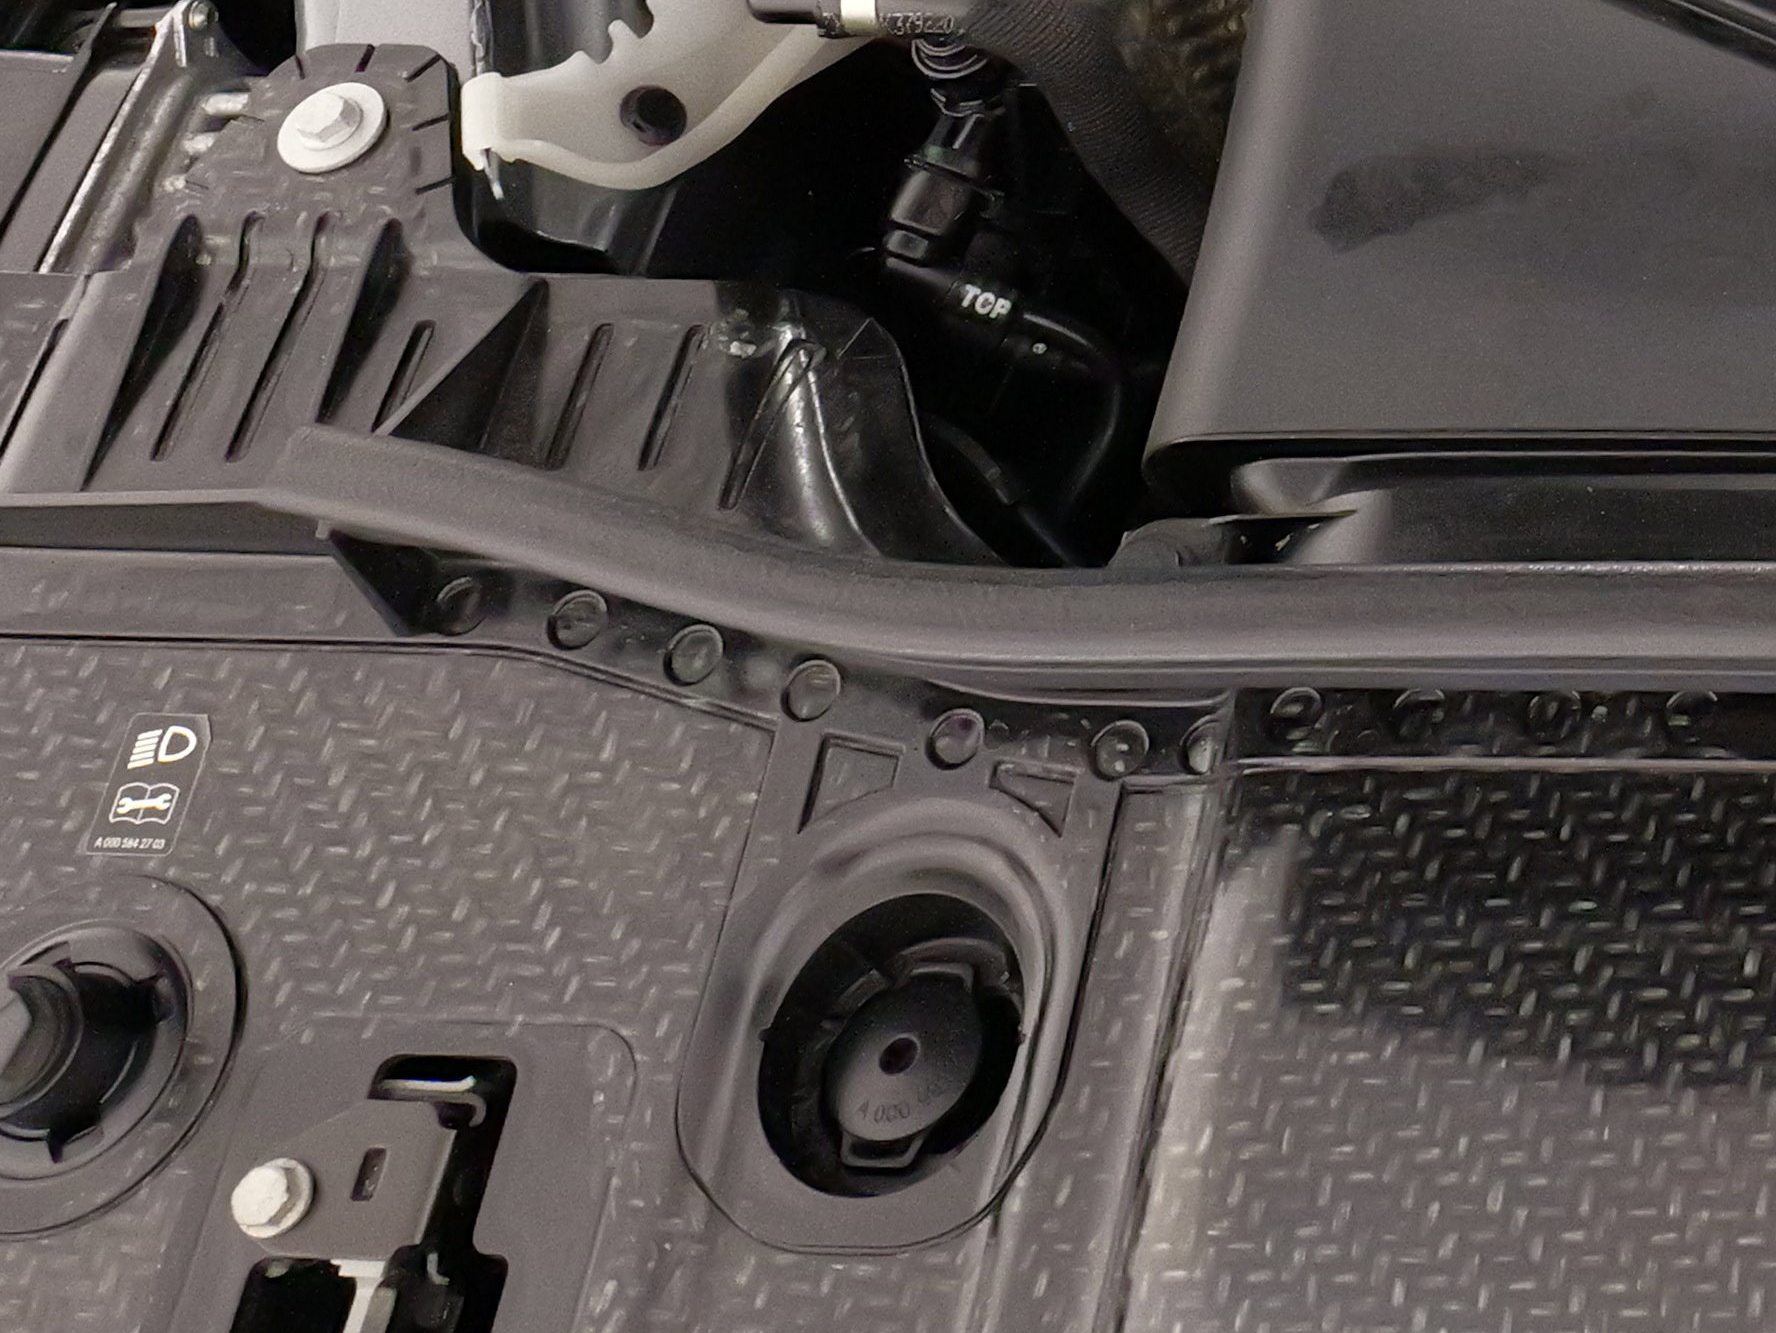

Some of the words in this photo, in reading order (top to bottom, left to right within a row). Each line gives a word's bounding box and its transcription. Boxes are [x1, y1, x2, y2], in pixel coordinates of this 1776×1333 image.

[961, 283, 1013, 319] TOP
[94, 837, 102, 848] A
[103, 837, 121, 848] 000
[139, 838, 153, 849] 27
